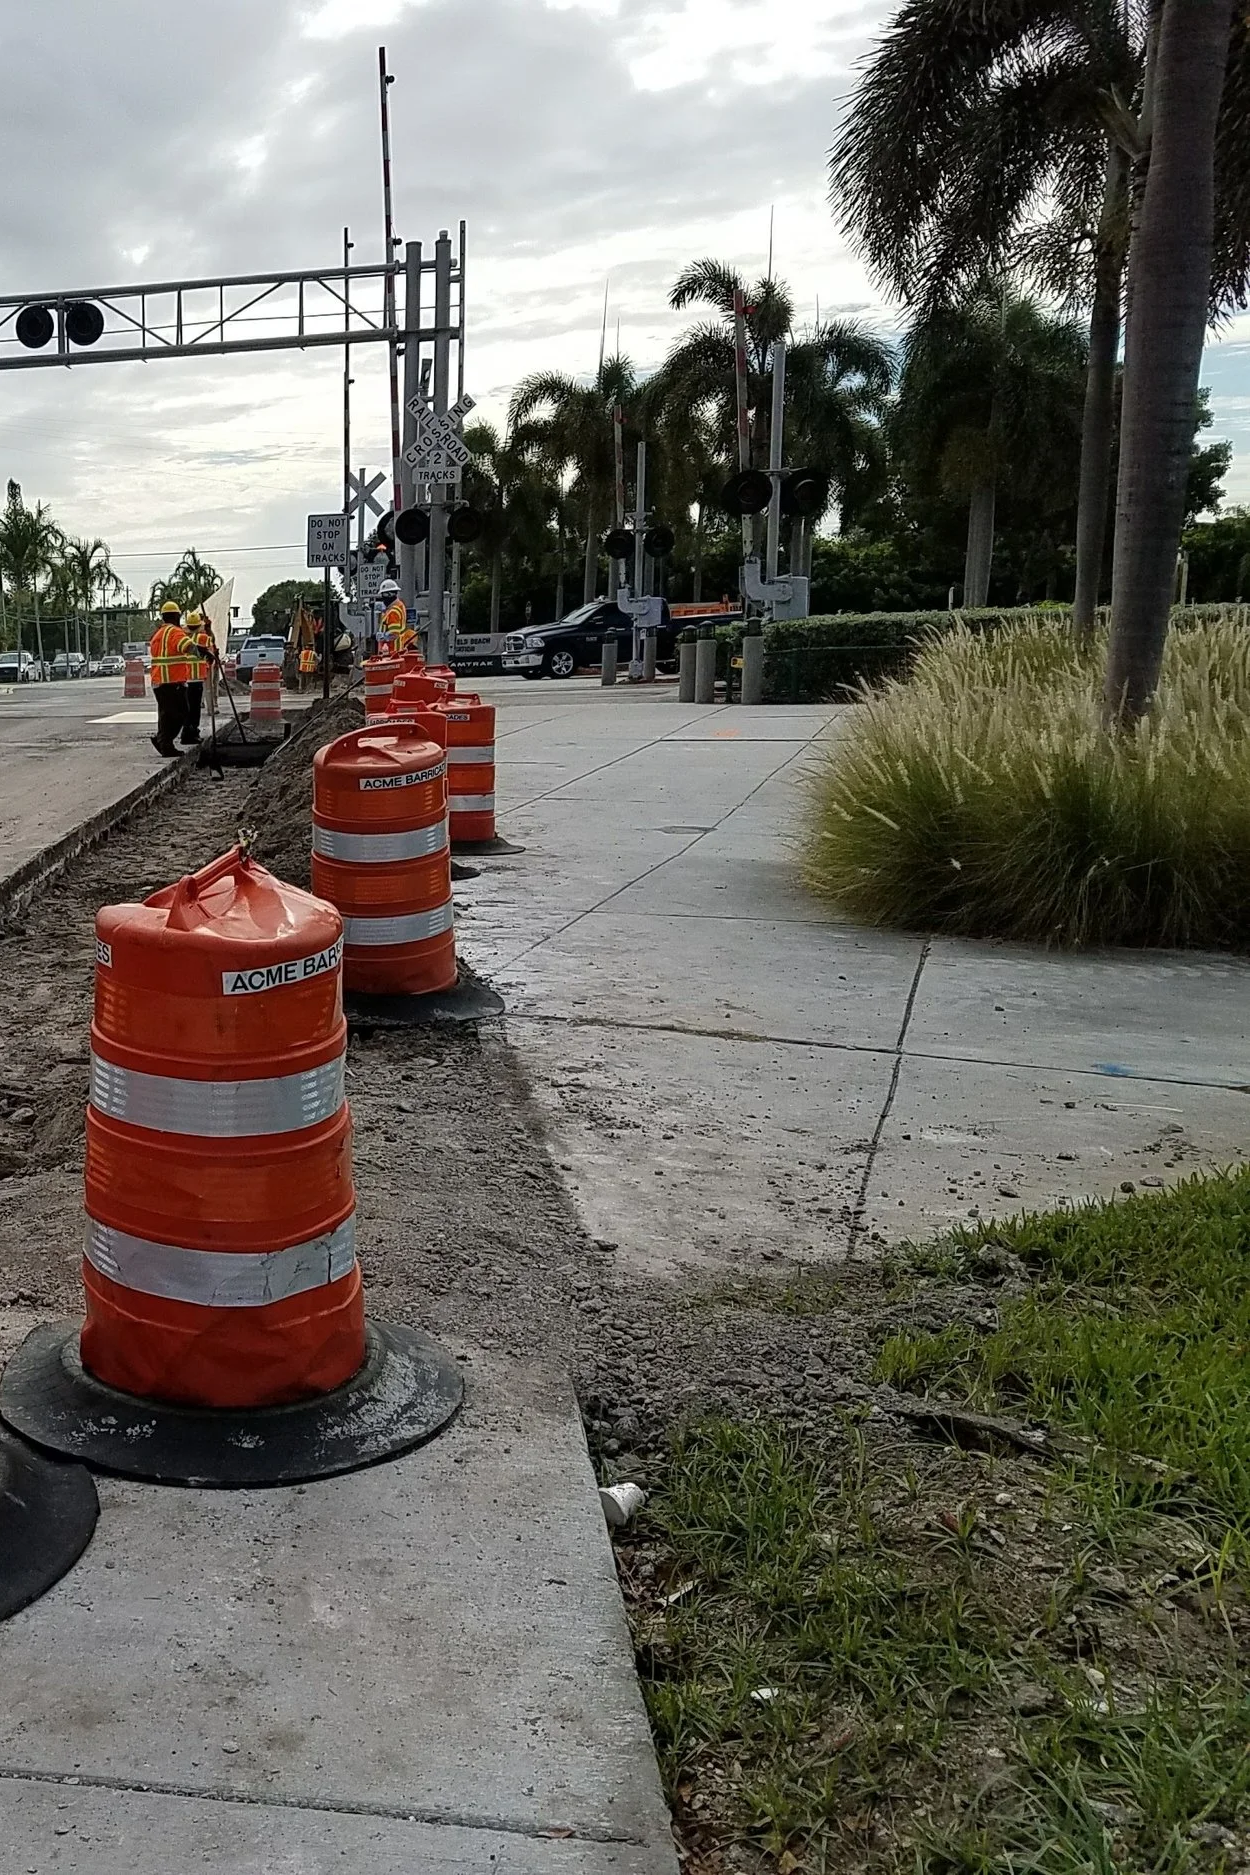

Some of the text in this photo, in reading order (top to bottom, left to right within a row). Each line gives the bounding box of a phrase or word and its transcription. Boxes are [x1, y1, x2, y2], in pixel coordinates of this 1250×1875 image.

[406, 397, 473, 463] CROSSING
[407, 398, 468, 462] RAIL ROAD
[433, 452, 442, 465] 2
[419, 471, 455, 480] TRACKS
[311, 518, 346, 528] DO NOT
[316, 530, 340, 539] STOP
[322, 542, 334, 551] ON
[311, 553, 345, 563] TRACKS
[363, 776, 402, 789] ACME
[230, 962, 298, 992] ACME
